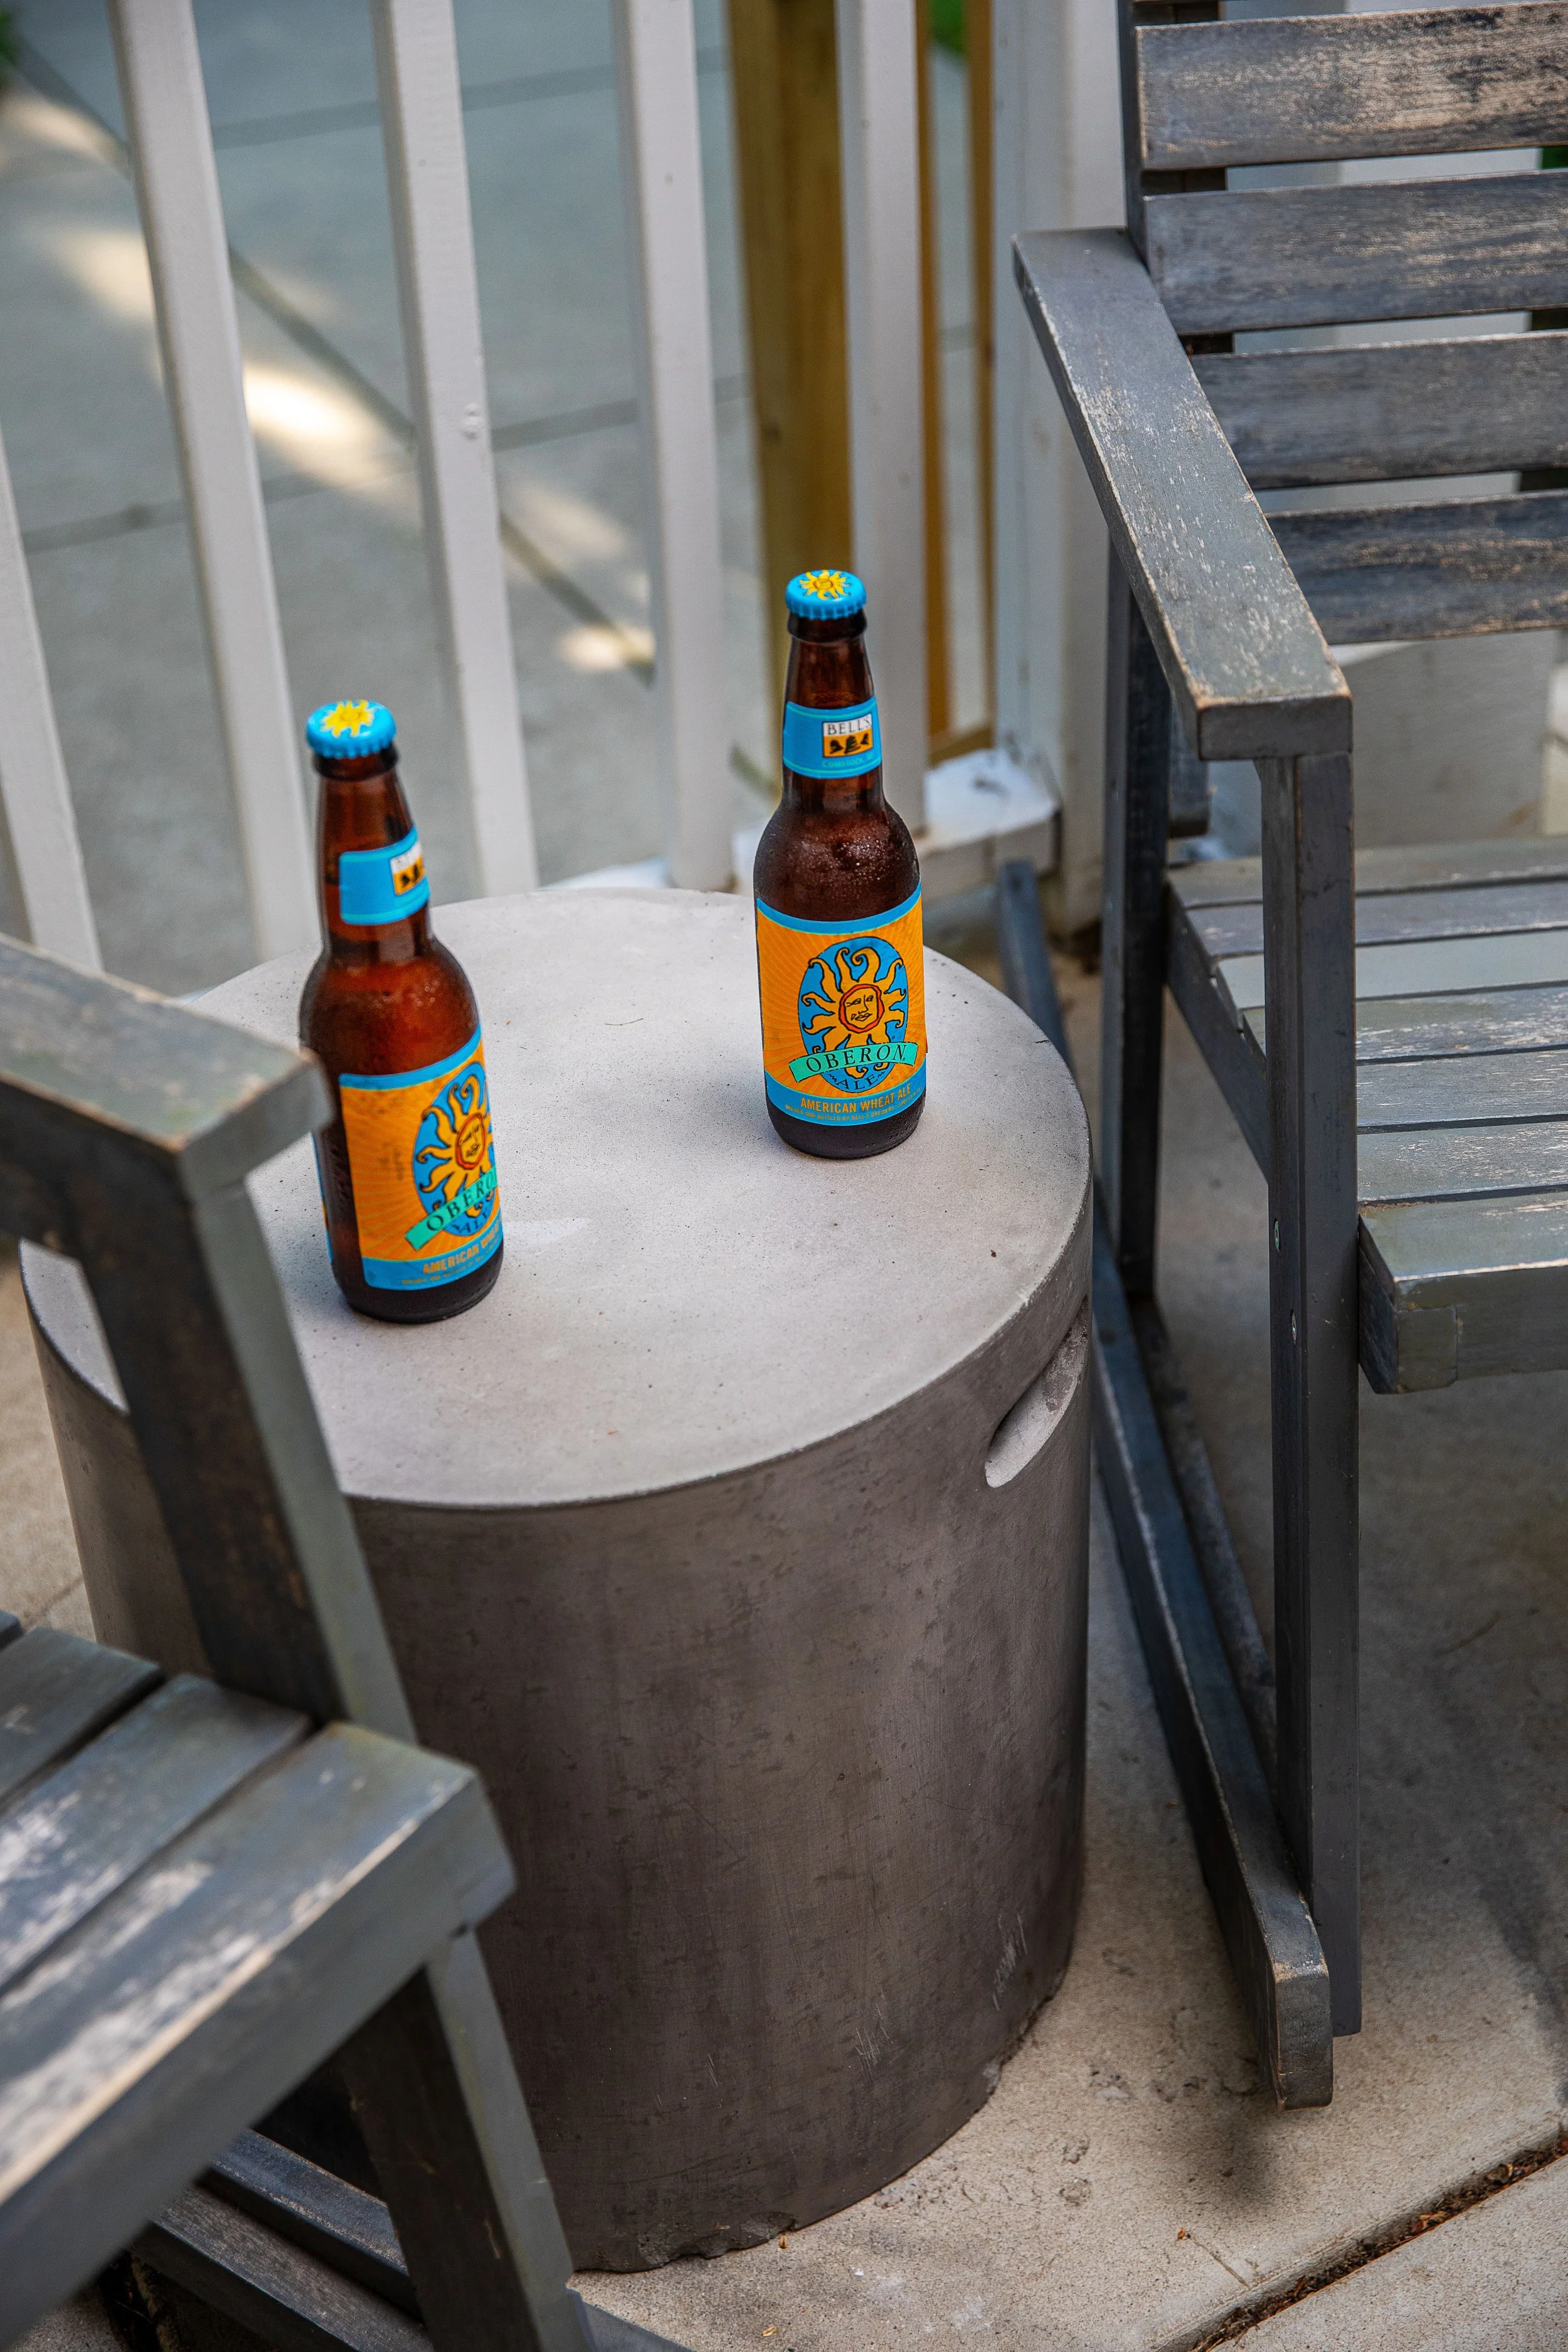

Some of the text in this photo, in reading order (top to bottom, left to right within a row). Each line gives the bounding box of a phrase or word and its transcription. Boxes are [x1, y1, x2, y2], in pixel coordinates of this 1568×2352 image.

[827, 719, 871, 735] BELL'S
[806, 1044, 907, 1073] OBERON
[836, 1074, 879, 1090] ALE
[801, 1083, 911, 1113] AMERICAN WHEAT ALE
[426, 1170, 497, 1231] OBERO
[423, 1244, 479, 1274] AMERICAN
